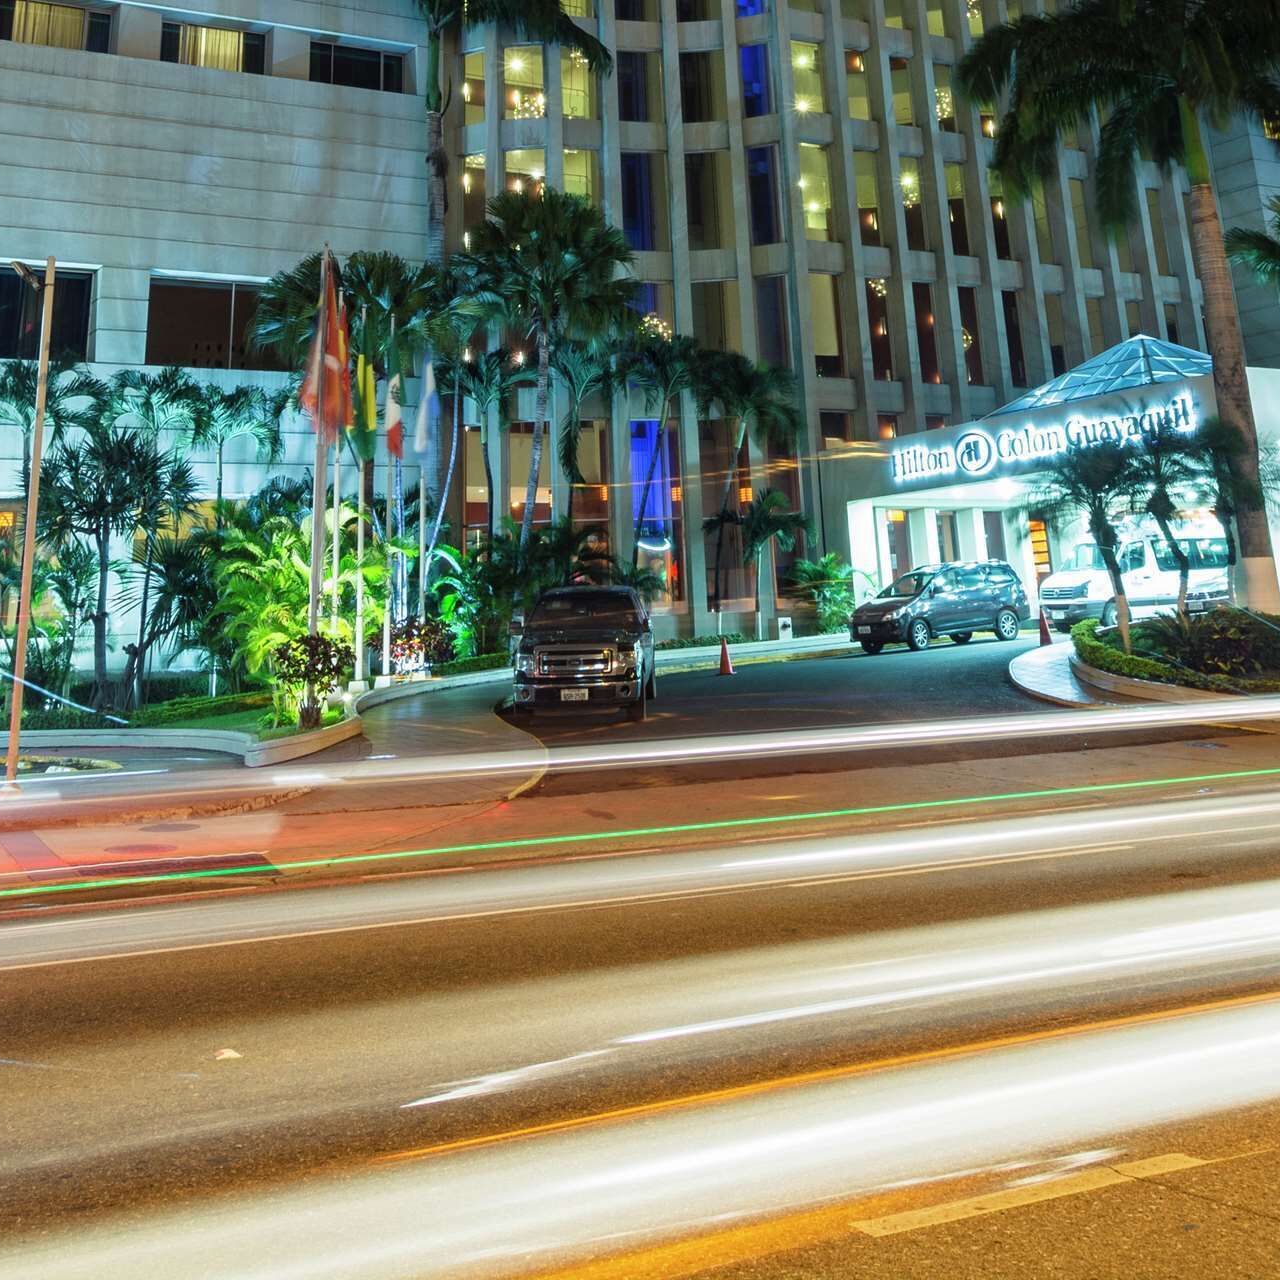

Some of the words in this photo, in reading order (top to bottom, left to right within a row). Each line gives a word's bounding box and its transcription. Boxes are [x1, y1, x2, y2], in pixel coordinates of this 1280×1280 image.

[892, 448, 950, 477] Hilton
[997, 428, 1062, 458] Colon
[1065, 398, 1190, 447] Guayaquil
